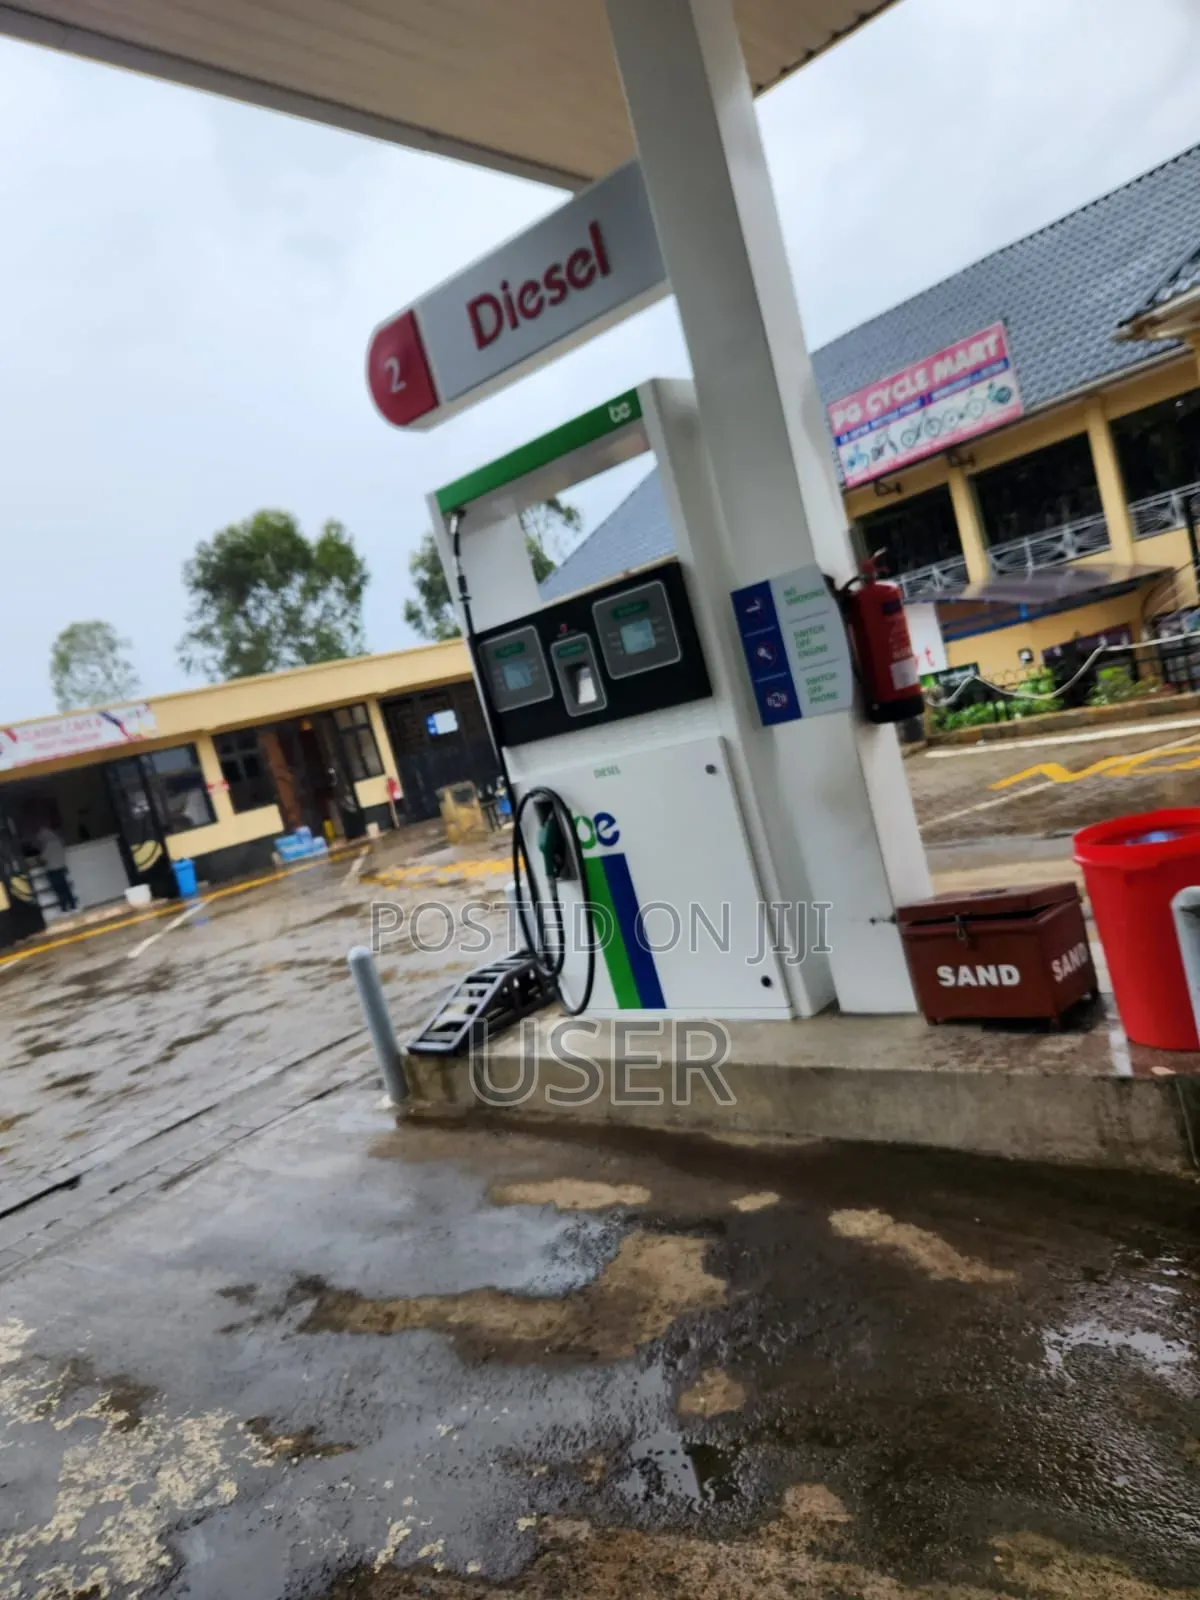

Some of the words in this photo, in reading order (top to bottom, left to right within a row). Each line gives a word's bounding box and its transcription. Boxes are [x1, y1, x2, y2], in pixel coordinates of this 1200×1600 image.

[465, 219, 612, 351] Diesel
[384, 356, 407, 393] 2
[865, 367, 929, 417] CYCLE
[931, 333, 999, 384] MART
[936, 963, 1021, 988] SAND
[1051, 941, 1089, 983] SAND
